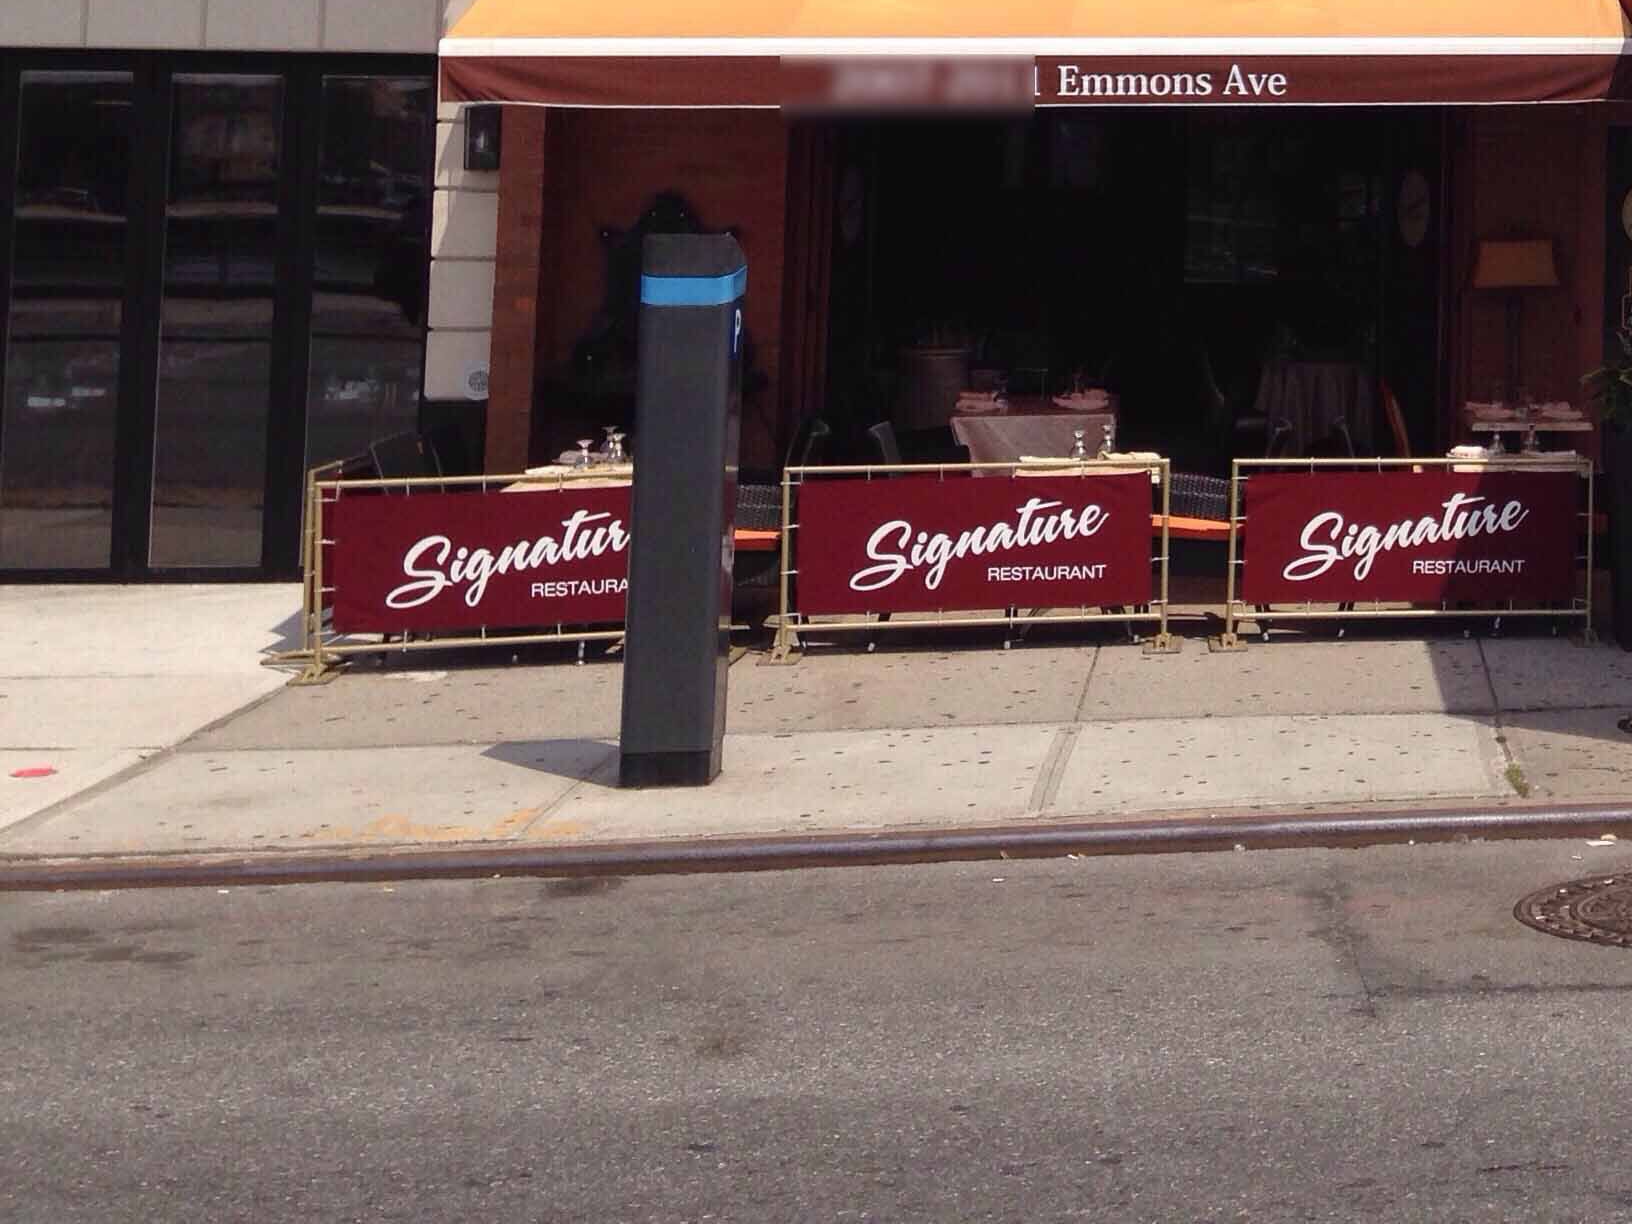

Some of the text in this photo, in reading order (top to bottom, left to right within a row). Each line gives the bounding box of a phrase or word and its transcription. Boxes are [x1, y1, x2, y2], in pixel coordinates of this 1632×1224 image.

[1057, 64, 1213, 97] Emmons
[1222, 63, 1288, 96] Ave
[849, 497, 1109, 592] Signature
[1283, 492, 1529, 581] Signature
[386, 510, 632, 610] Signatur
[987, 564, 1106, 582] RESTAURANT
[1412, 559, 1525, 576] RESTAURANT
[531, 578, 629, 598] RESTAURA
